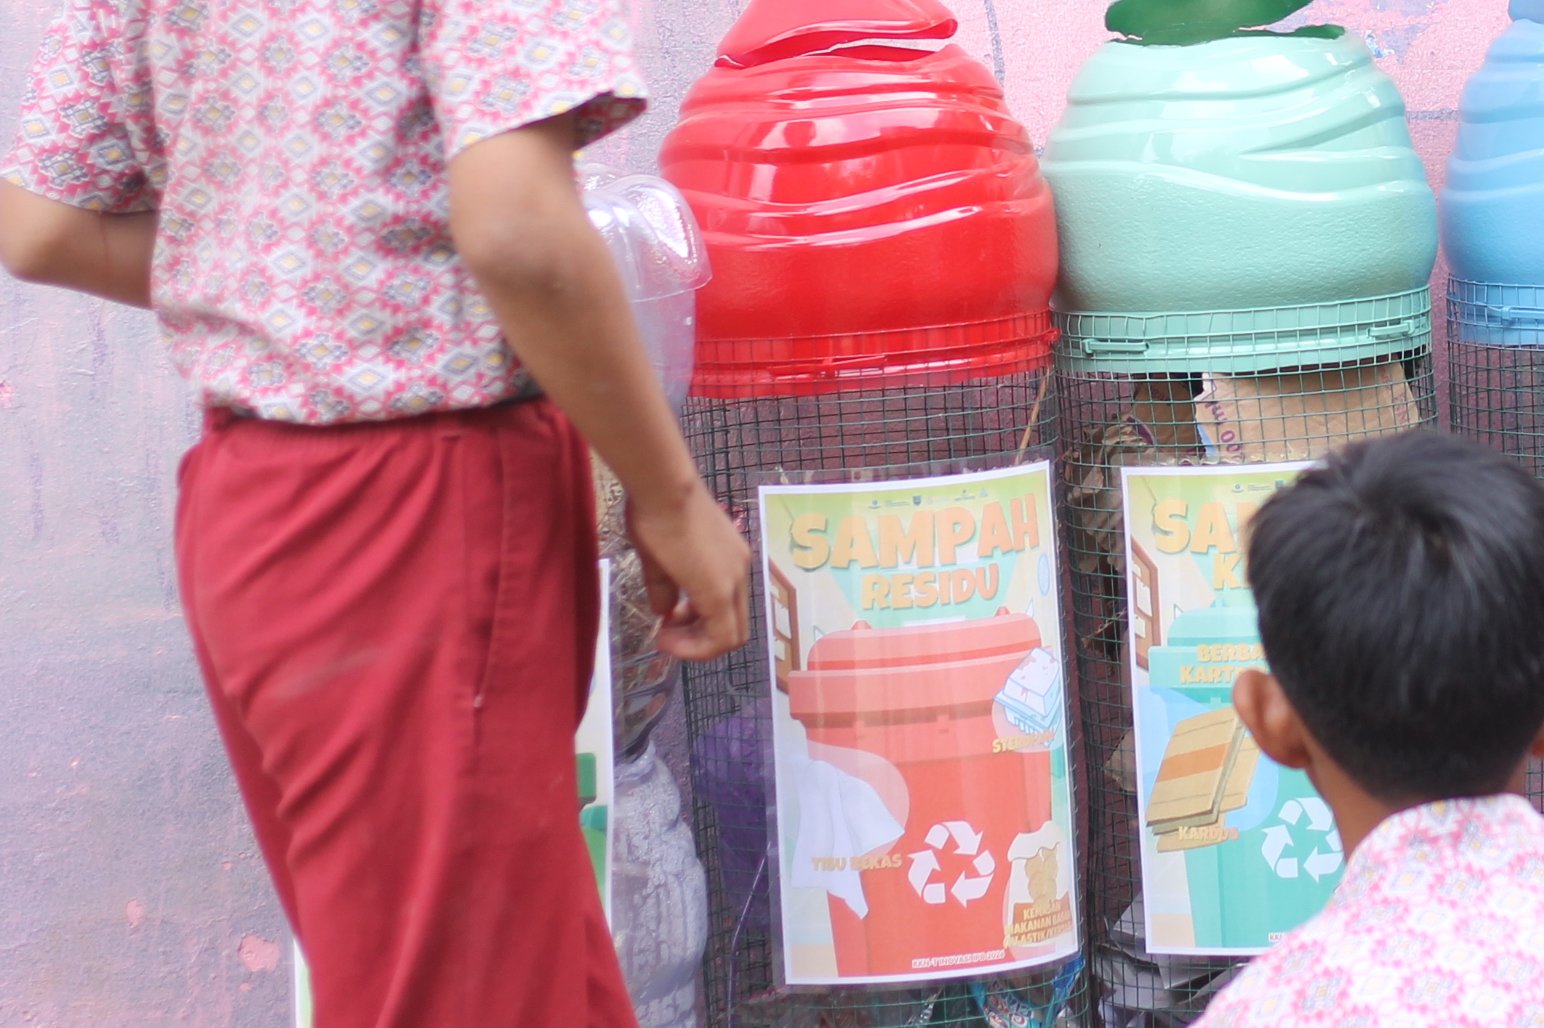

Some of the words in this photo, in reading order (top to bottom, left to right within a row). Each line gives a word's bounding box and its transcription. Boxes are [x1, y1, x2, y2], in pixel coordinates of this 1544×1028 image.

[790, 491, 1041, 571] SAMPAH
[861, 562, 1000, 611] RESIDU
[1178, 825, 1240, 841] KARDUS
[849, 853, 903, 872] BEKAS
